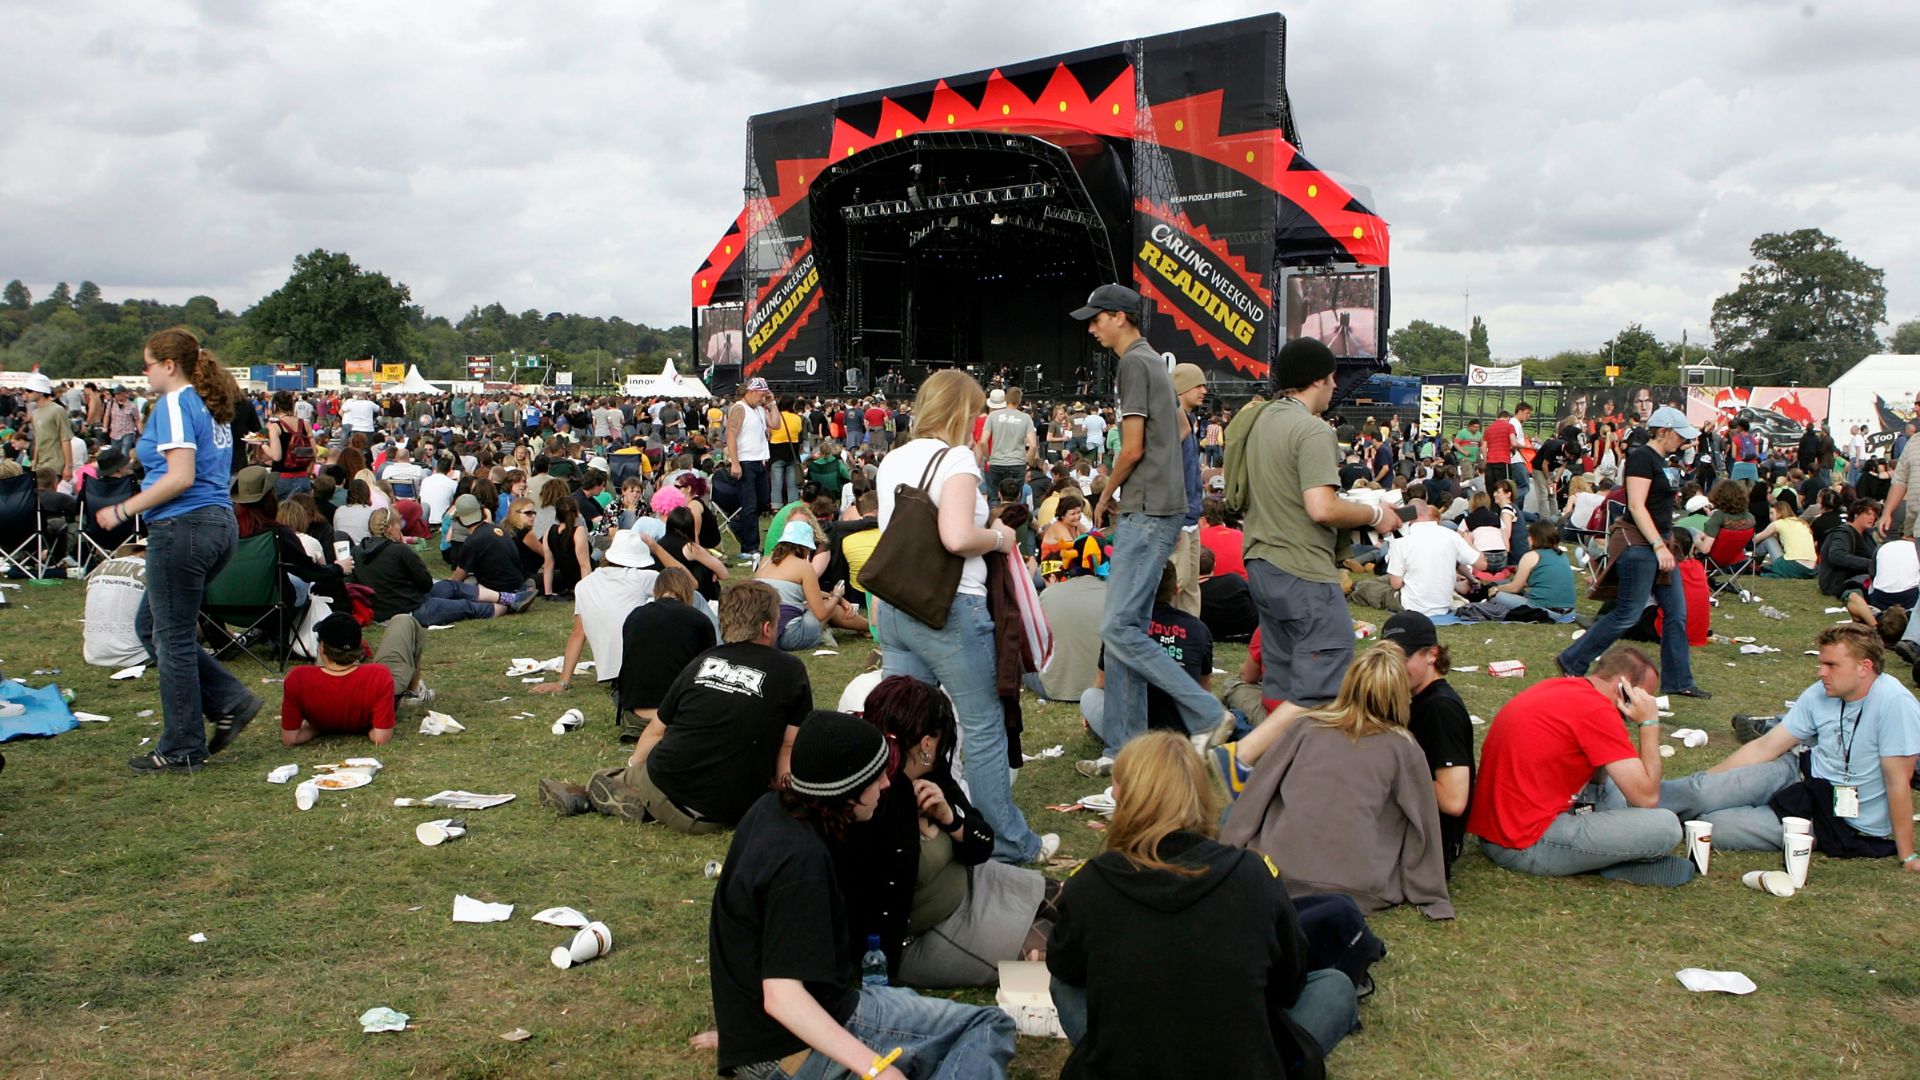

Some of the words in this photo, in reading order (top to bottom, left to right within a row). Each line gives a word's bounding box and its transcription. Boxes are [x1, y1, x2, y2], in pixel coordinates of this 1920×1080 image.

[1188, 193, 1213, 202] FIDDLER
[745, 291, 782, 338] CARLING
[781, 254, 814, 296] WEEKEND
[748, 266, 820, 354] READING
[1138, 240, 1256, 346] READING
[1151, 224, 1212, 278] CARLING
[1211, 269, 1264, 322] WEEKEND
[1160, 635, 1175, 644] and
